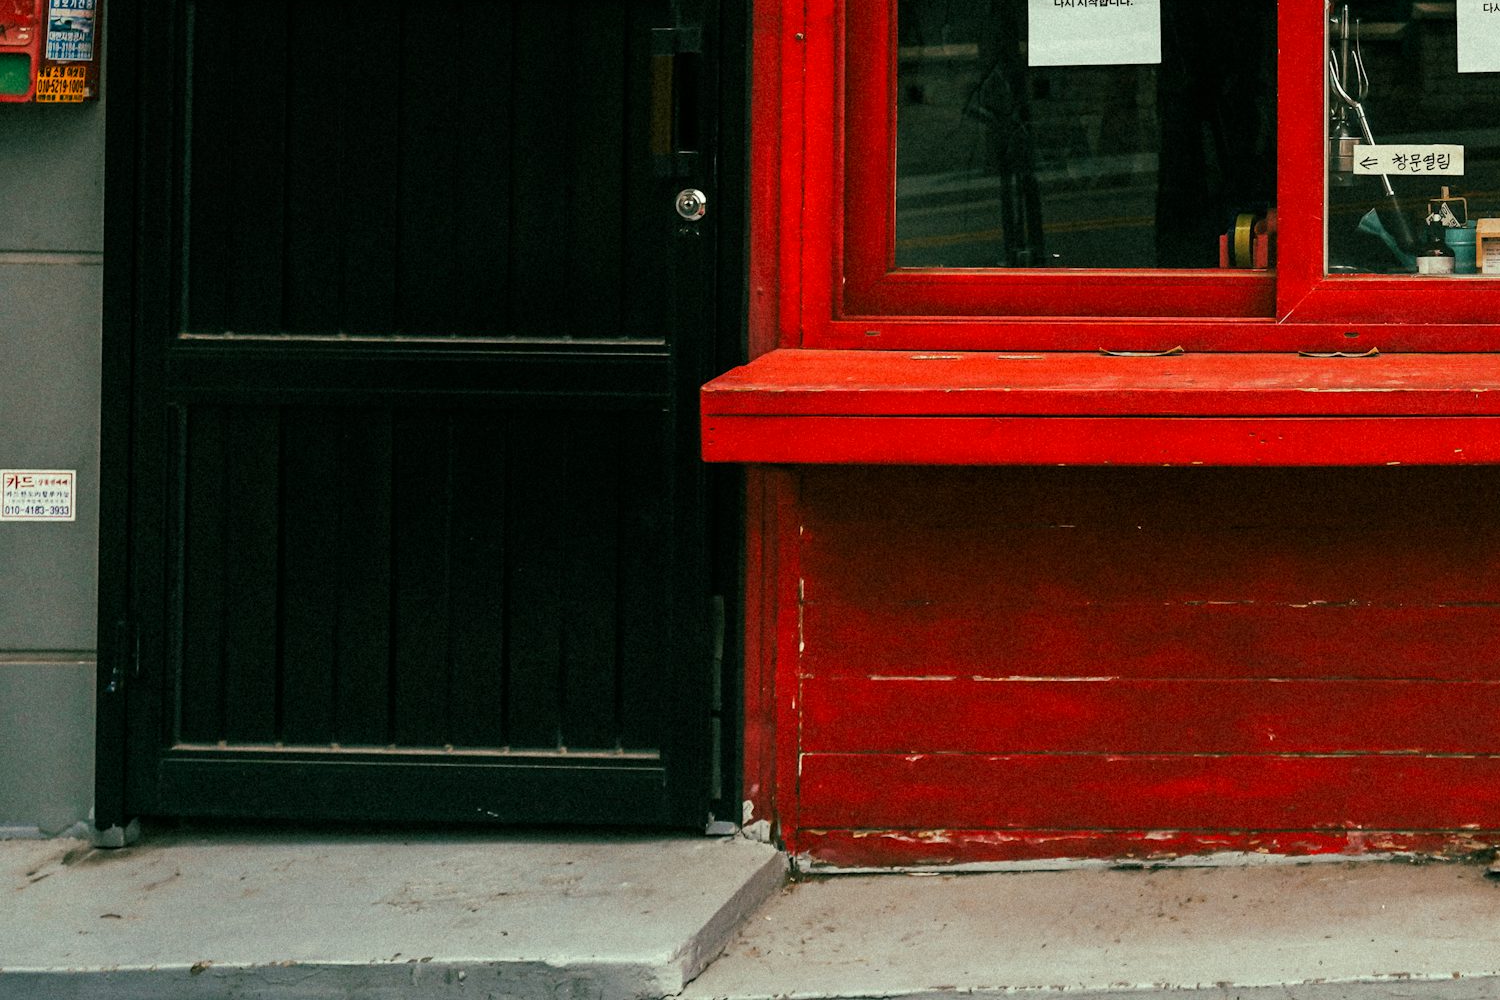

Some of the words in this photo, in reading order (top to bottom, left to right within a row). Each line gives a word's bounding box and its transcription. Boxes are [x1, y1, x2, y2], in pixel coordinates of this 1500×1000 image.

[1391, 153, 1450, 173] 창문열림
[7, 475, 35, 489] 카드
[5, 505, 69, 515] 010-4183-3933
